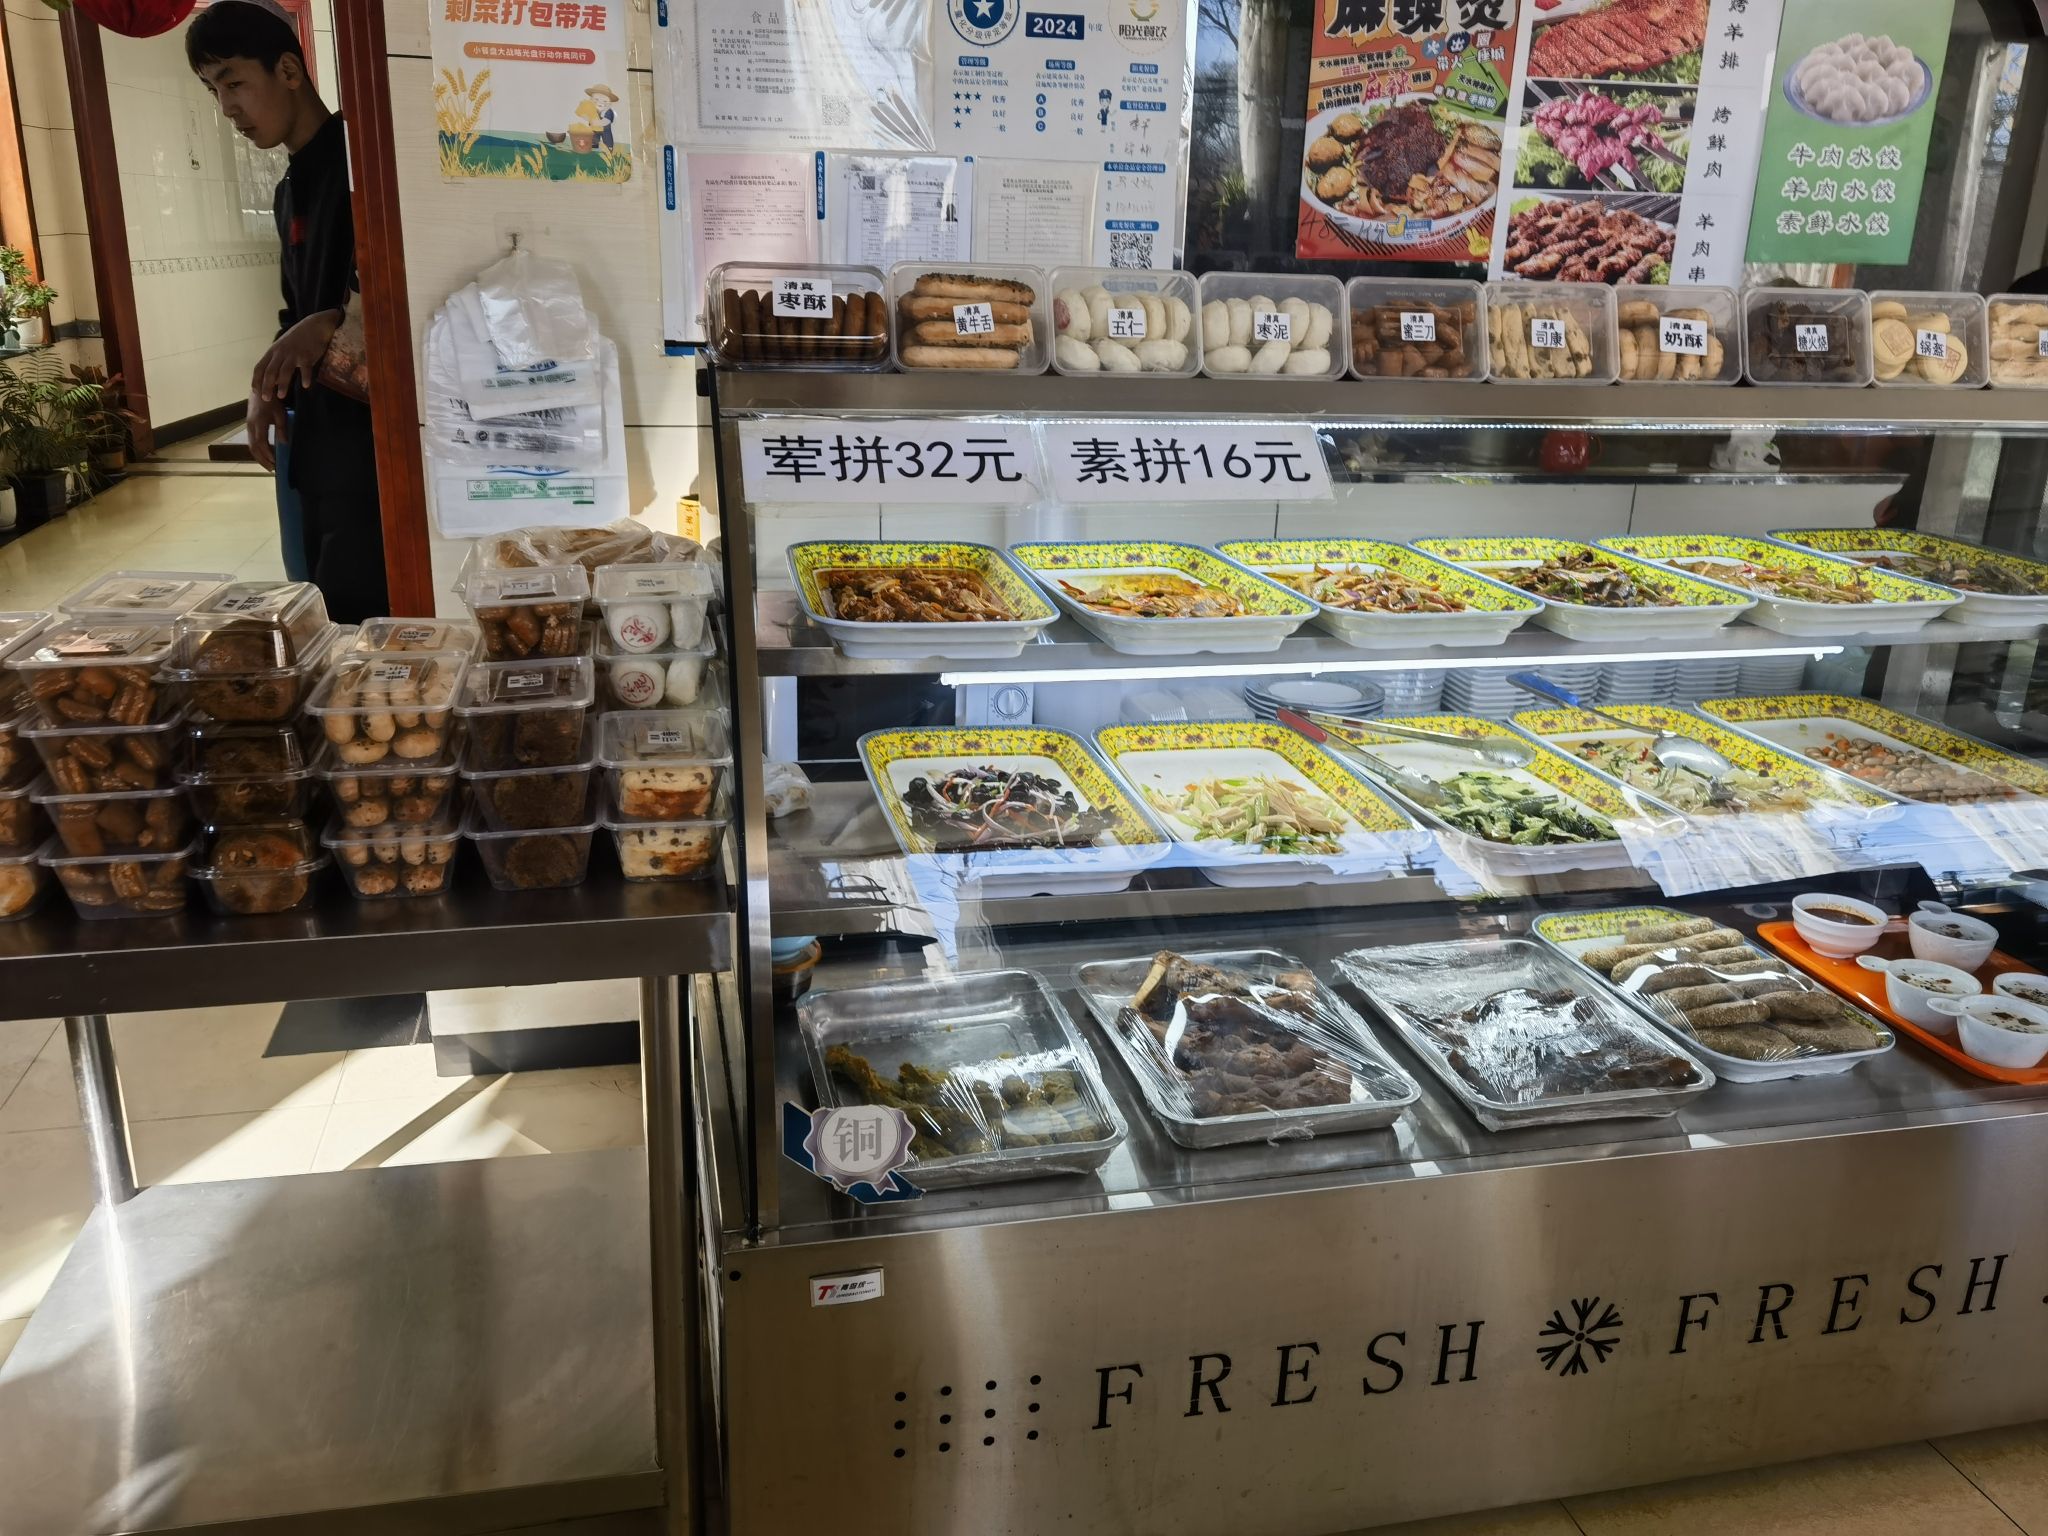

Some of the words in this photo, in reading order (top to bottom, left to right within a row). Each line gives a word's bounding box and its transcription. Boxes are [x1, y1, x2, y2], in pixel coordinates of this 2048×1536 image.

[444, 0, 607, 31] 剩菜打包带走
[1033, 17, 1077, 36] 2024
[1088, 23, 1103, 32] 年度
[1719, 0, 1749, 70] 烤羊排
[1788, 144, 1902, 169] 牛肉水饺
[1782, 177, 1896, 202] 羊肉水饺
[1688, 213, 1715, 283] 羊肉串
[783, 281, 813, 290] 清真
[778, 292, 826, 310] 枣酥
[963, 305, 980, 316] 清真
[1117, 310, 1134, 319] 清真
[1263, 313, 1280, 323] 清真
[1410, 314, 1424, 323] 清真
[956, 316, 991, 334] 黄牛舌
[1112, 320, 1145, 337] 五仁
[1256, 323, 1290, 340] 枣泥
[1403, 323, 1435, 341] 蜜三刀
[1540, 322, 1555, 330] 清真
[1669, 321, 1692, 331] 清真
[1804, 326, 1818, 335] 清真
[1535, 330, 1563, 347] 司康
[1665, 331, 1703, 349] 奶酥
[1798, 335, 1828, 352] 糖火烧
[1925, 332, 1939, 341] 清真
[762, 434, 1022, 484] 荤拼32元
[1071, 437, 1311, 485] 素拼16元
[833, 1117, 883, 1162] 铜
[1669, 1254, 2008, 1354] FRESH
[1091, 1320, 1485, 1430] FRESH
